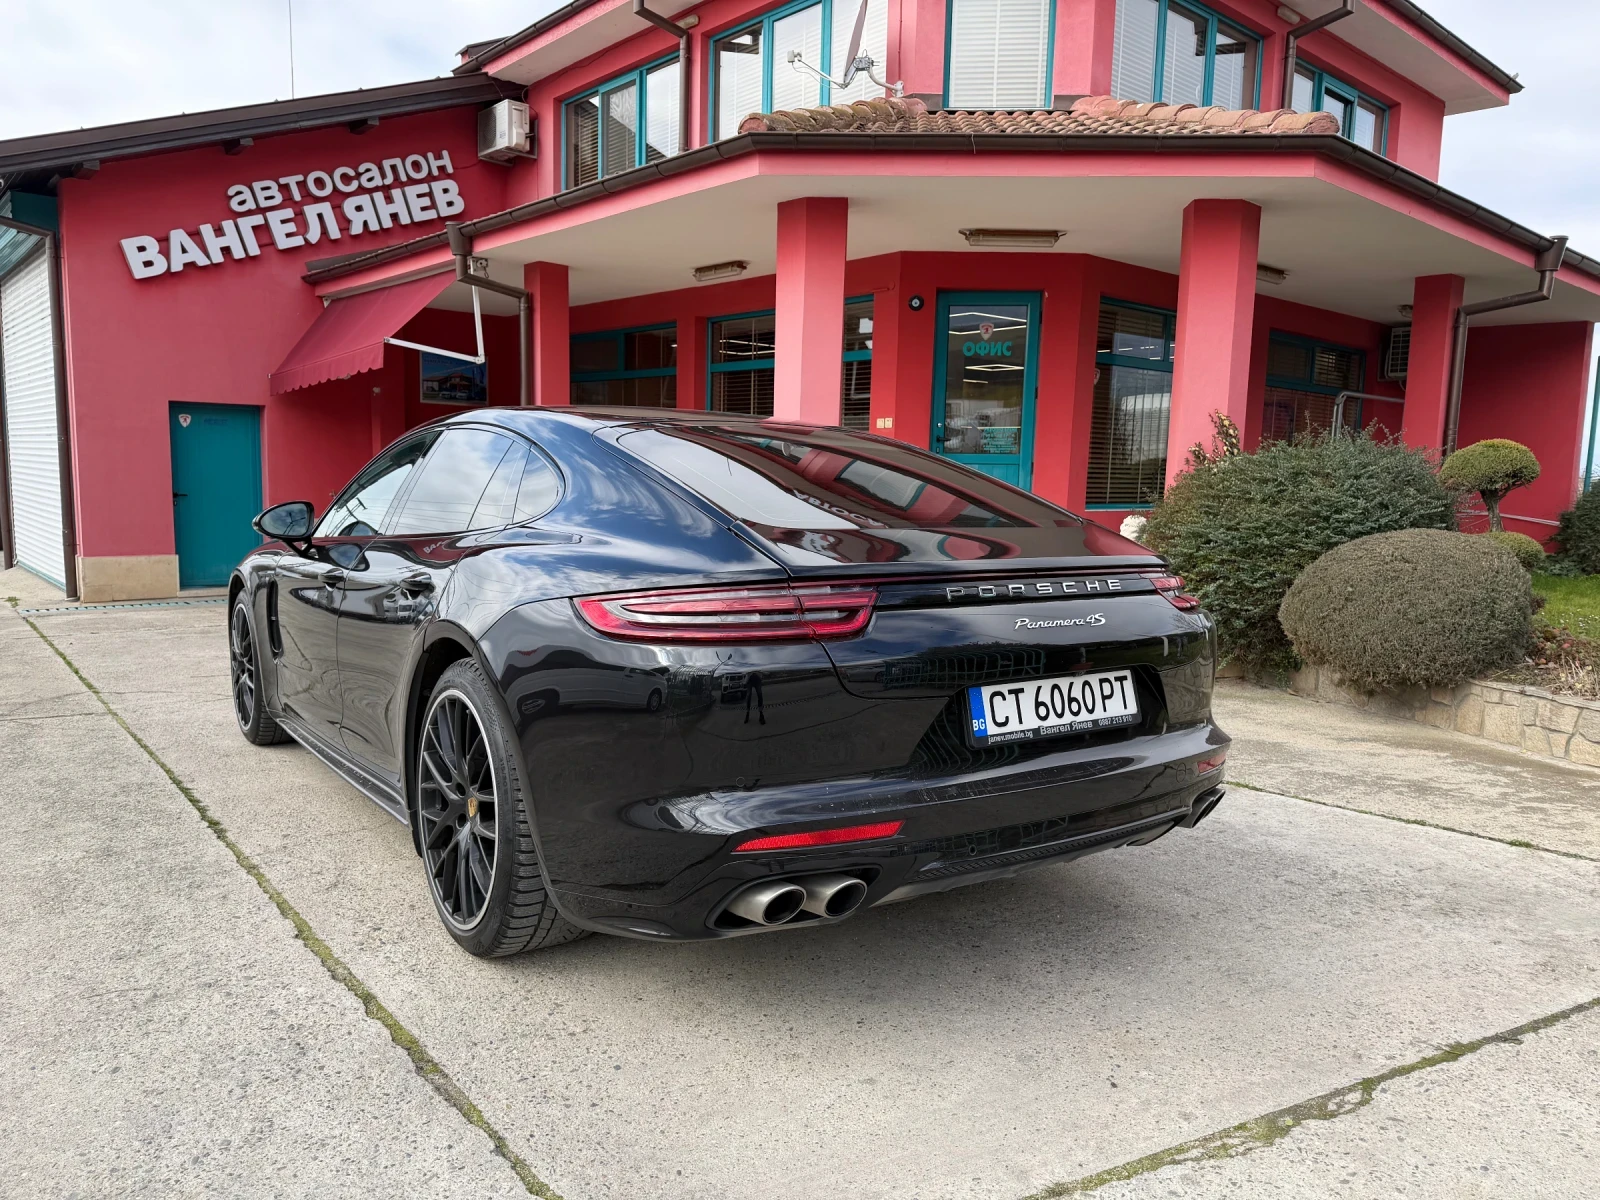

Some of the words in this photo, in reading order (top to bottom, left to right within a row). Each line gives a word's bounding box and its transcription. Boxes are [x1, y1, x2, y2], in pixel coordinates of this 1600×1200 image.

[227, 150, 454, 213] автосалон
[120, 201, 342, 279] ВАНГЕЛ
[342, 179, 465, 235] ЯНЕВ
[962, 341, 1012, 357] ОФИС
[946, 579, 1122, 603] PORSCHE
[1014, 618, 1085, 630] Panamera
[1086, 613, 1106, 627] 4S
[989, 688, 1025, 728] CT
[972, 719, 986, 732] BG
[1040, 724, 1070, 735] Вангел
[1072, 721, 1093, 732] Янев
